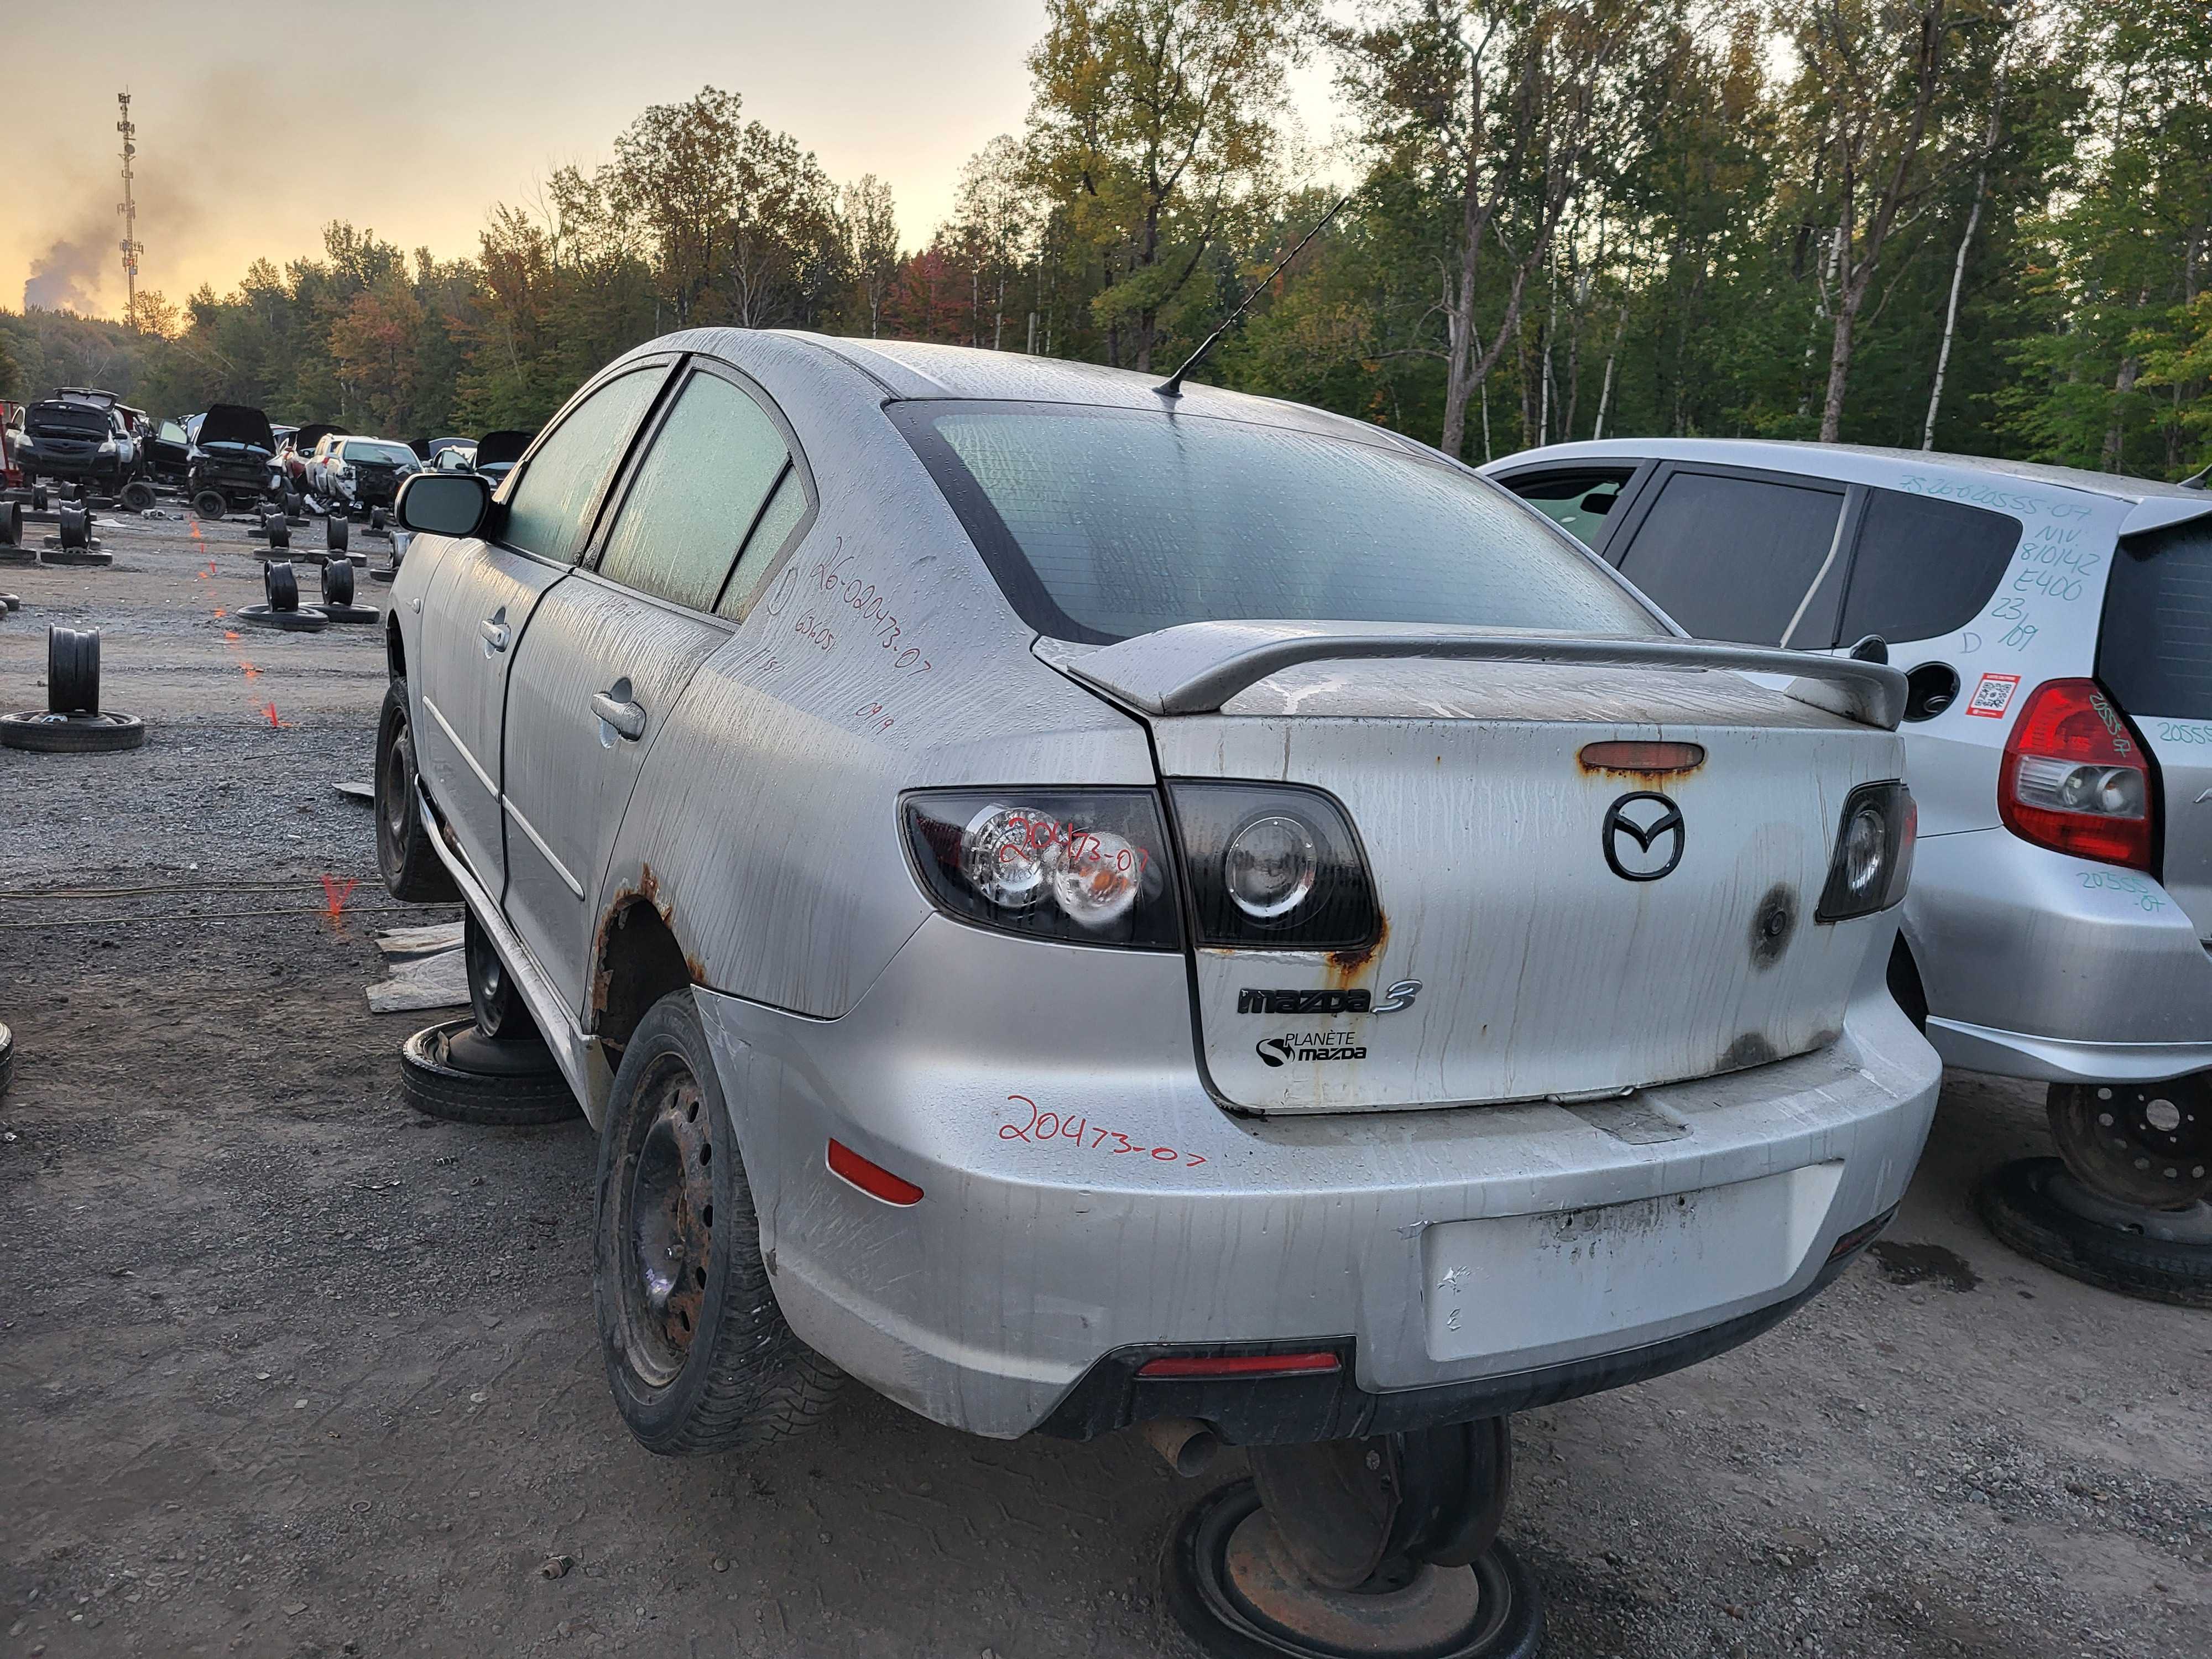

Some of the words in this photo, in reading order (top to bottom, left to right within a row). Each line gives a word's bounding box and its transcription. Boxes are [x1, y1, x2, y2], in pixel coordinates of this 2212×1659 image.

[1960, 632, 1982, 654] D
[1000, 817, 1149, 873] 20473-07
[2076, 870, 2148, 893] 20555
[1284, 1030, 1356, 1047] PLANÈTE
